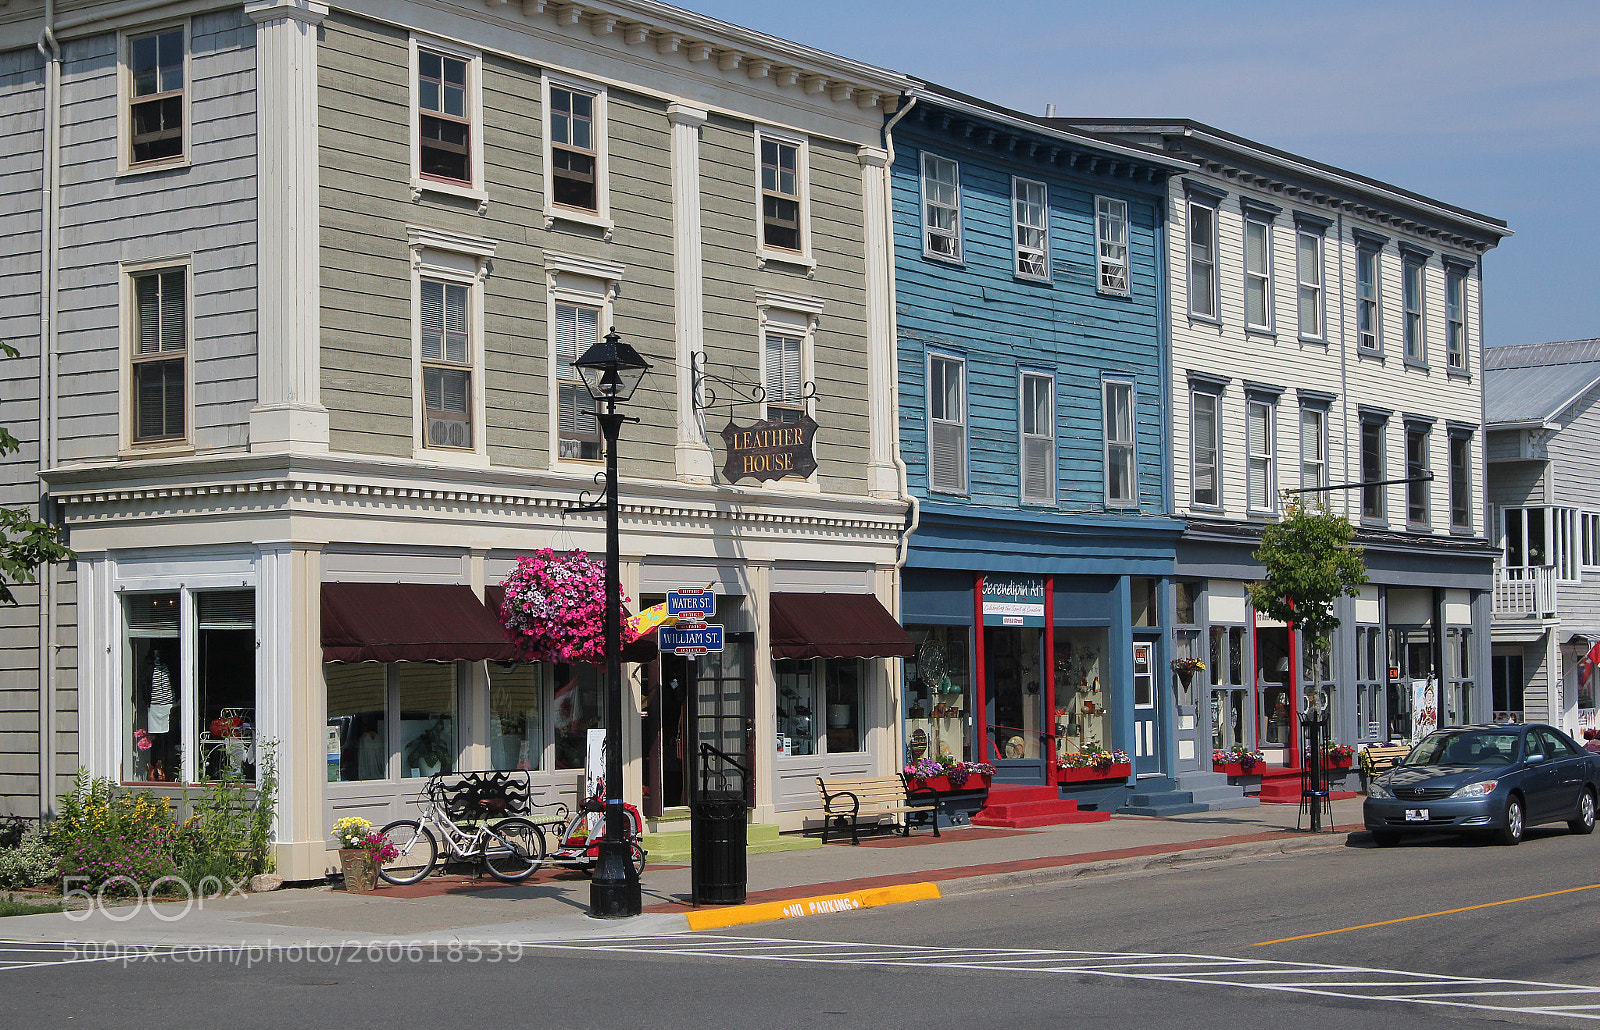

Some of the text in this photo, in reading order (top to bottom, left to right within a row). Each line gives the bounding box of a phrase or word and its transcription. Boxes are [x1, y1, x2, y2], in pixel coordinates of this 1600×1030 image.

[733, 427, 804, 450] LEATHER
[743, 452, 794, 474] HOUSE
[1030, 579, 1044, 597] Art
[671, 597, 711, 609] WATER ST.
[663, 632, 720, 644] WILLIAM ST.
[788, 898, 853, 918] NO PARKING
